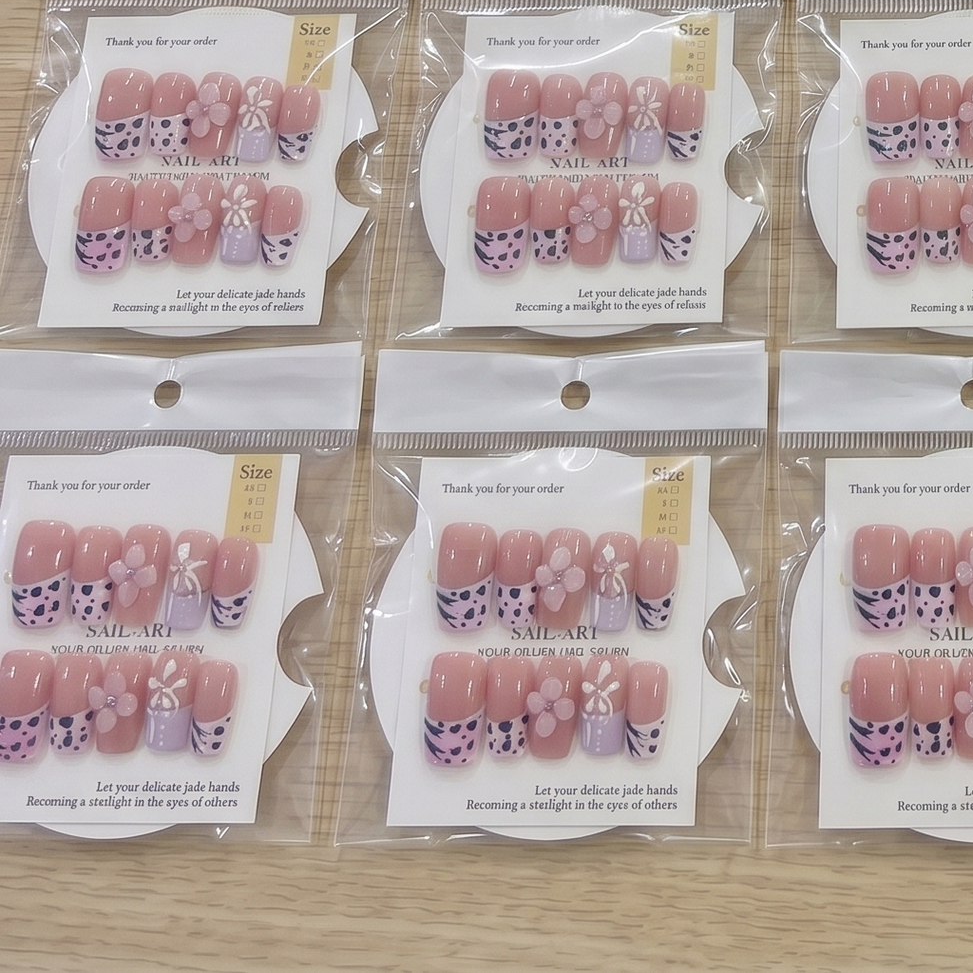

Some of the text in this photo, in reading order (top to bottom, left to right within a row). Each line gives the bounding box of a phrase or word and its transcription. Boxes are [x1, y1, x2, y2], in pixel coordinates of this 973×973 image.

[299, 22, 331, 36] Size
[677, 23, 711, 37] Size
[486, 36, 601, 49] Thank you for your order
[860, 38, 973, 52] Thank you for your order
[577, 286, 708, 301] Let your delicate jade hands
[239, 464, 273, 480] Size
[652, 466, 685, 483] Size
[26, 479, 152, 494] Thank you for your order
[441, 482, 565, 497] Thank you for your order
[848, 482, 972, 498] Thank you for your order
[95, 780, 241, 796] Let your delicate jade hands
[534, 783, 679, 799] Let your delicate jade hands
[79, 798, 86, 807] a
[133, 796, 145, 807] in
[147, 795, 164, 808] the
[191, 795, 205, 808] of
[519, 802, 526, 810] a
[574, 799, 585, 810] in
[587, 798, 605, 810] the
[631, 798, 644, 810] of
[644, 798, 678, 811] others
[951, 803, 958, 811] a
